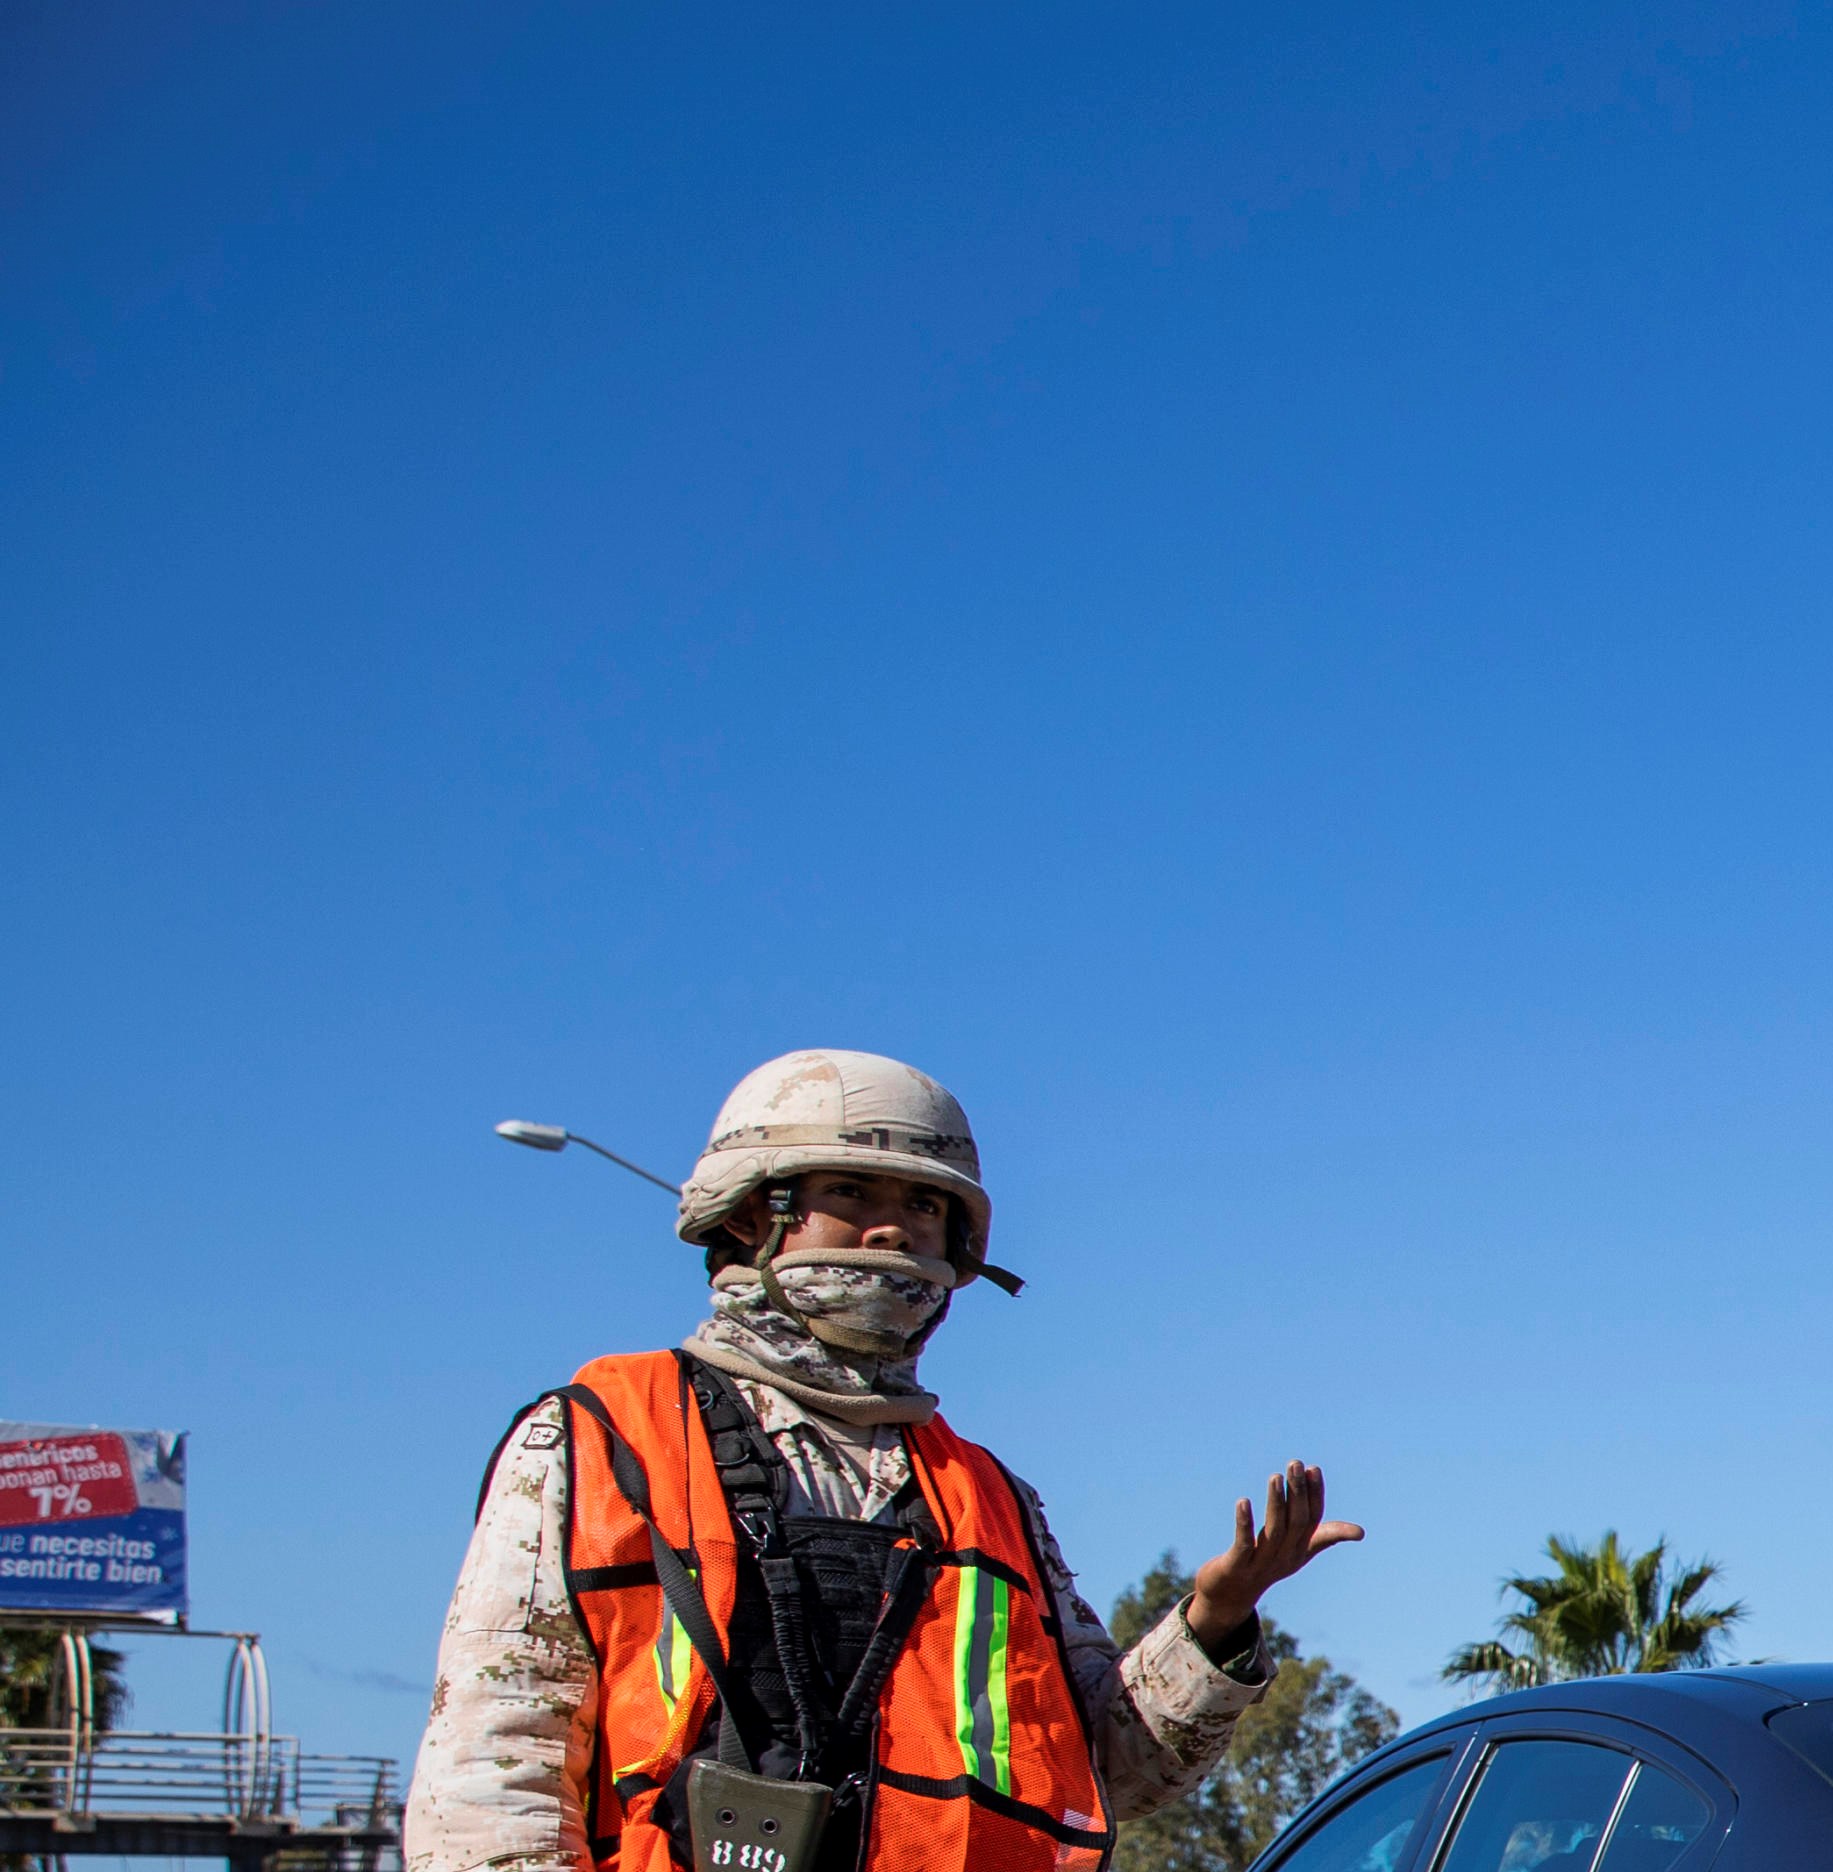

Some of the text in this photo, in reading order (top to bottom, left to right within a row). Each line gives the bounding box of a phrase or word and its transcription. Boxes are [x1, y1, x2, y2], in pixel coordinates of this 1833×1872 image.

[63, 1461, 122, 1482] hasta
[29, 1482, 93, 1518] 7%
[0, 1532, 156, 1560] ue necesitas
[0, 1556, 162, 1584] sentirte bien
